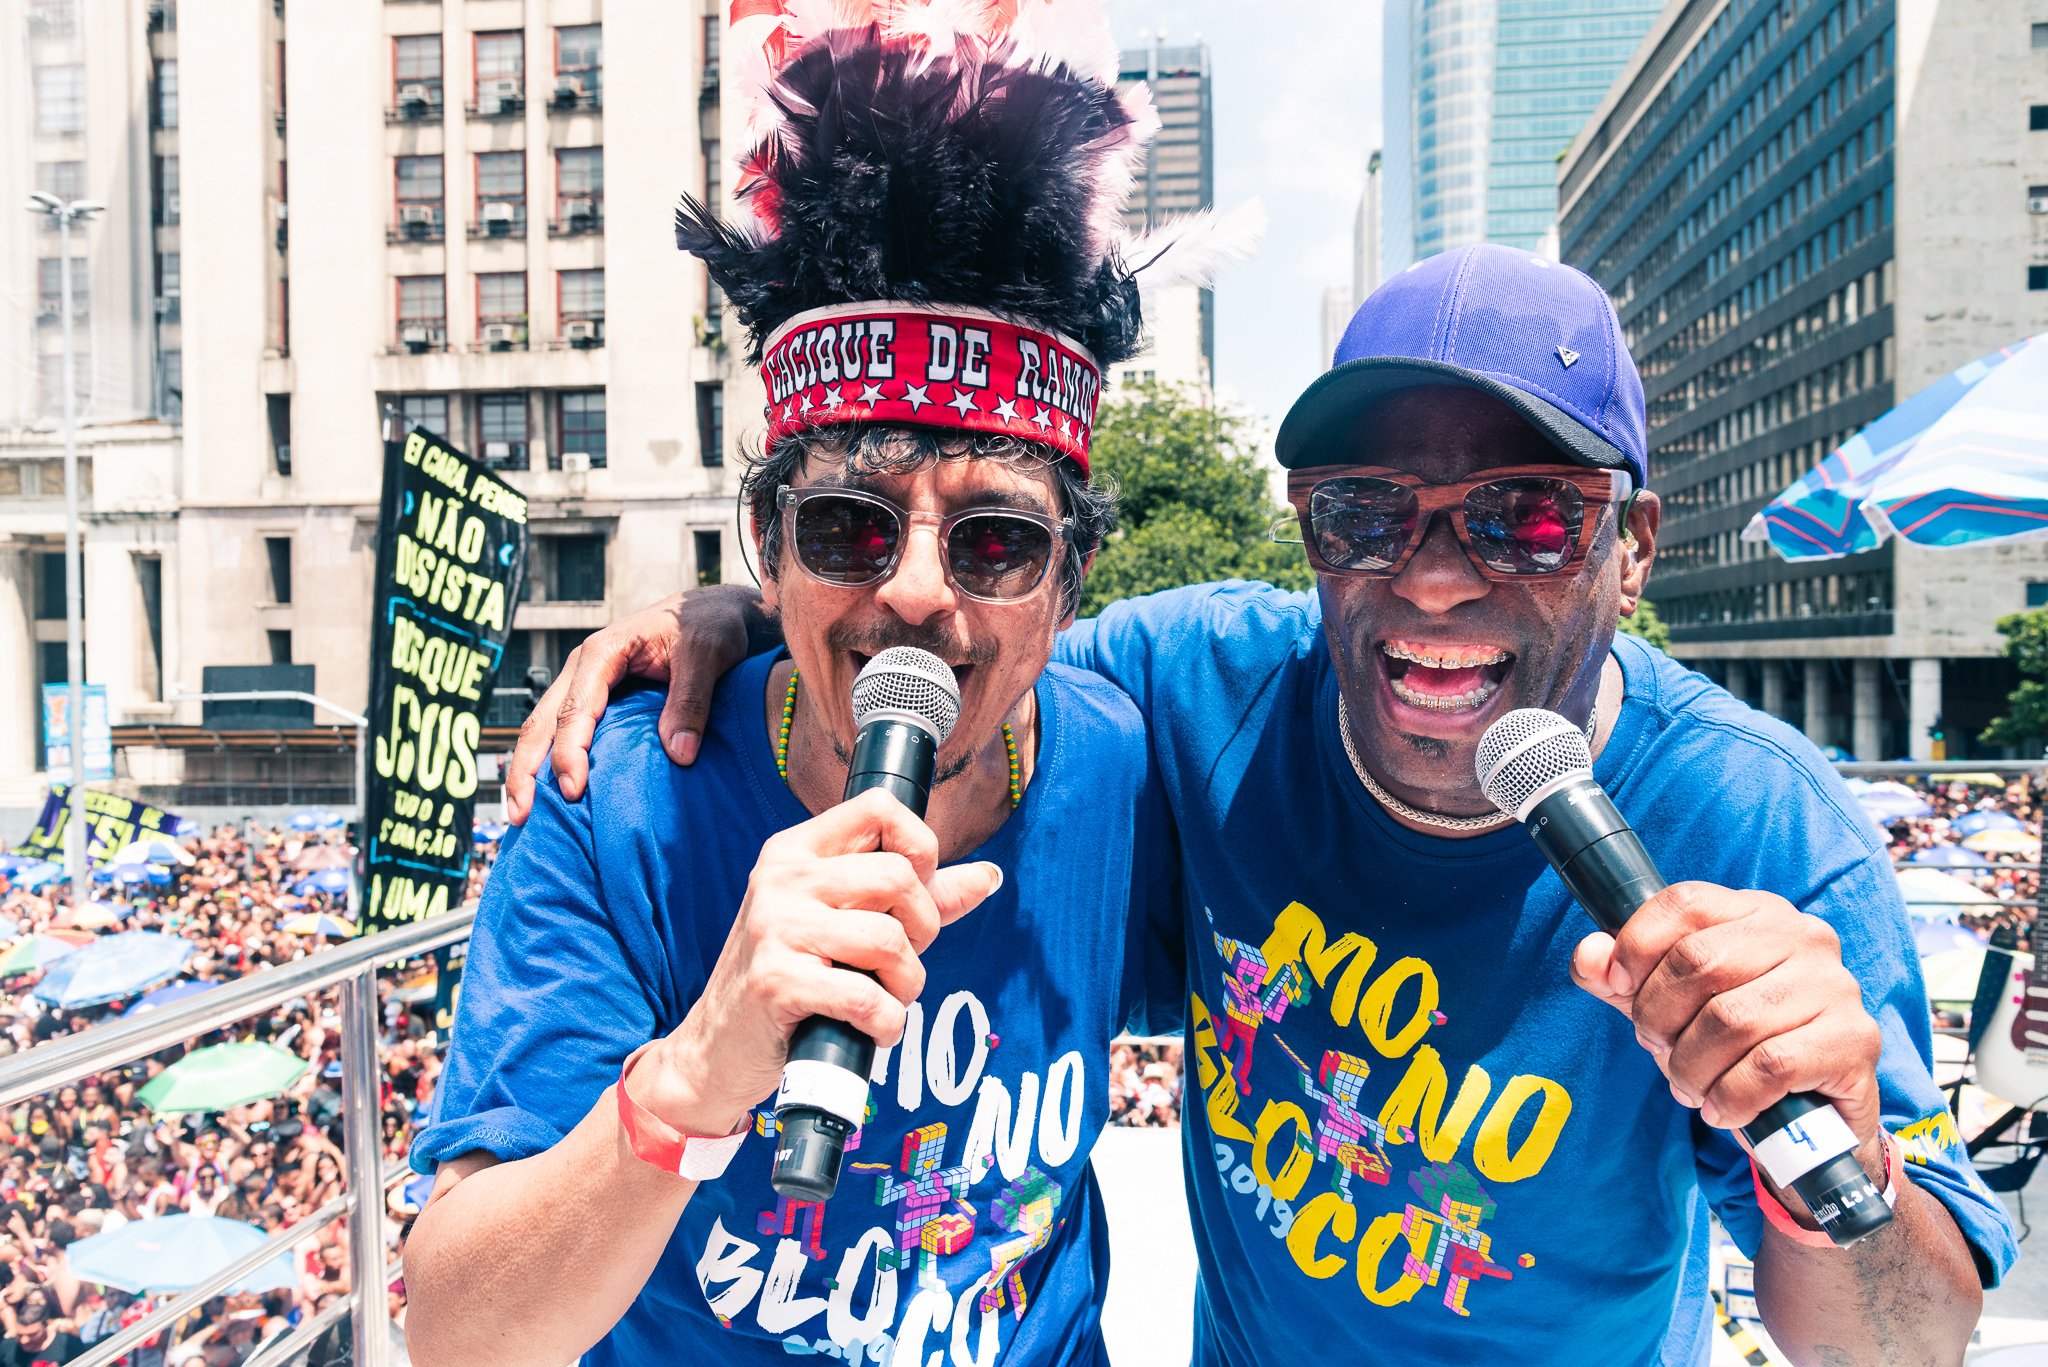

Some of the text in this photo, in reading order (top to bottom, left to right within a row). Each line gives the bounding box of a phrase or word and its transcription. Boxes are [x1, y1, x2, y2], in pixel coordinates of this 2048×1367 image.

[764, 316, 1099, 428] CACIQUE DE RAMOS
[416, 491, 486, 564] NÃO
[421, 446, 469, 497] CARA,
[1567, 785, 1604, 805] SURE
[1259, 900, 1439, 1059] MO
[961, 1051, 1085, 1186] NO
[1377, 1044, 1573, 1183] NO
[1784, 1121, 1818, 1152] 4
[695, 1214, 899, 1350] BLO
[1285, 1191, 1439, 1308] CO
